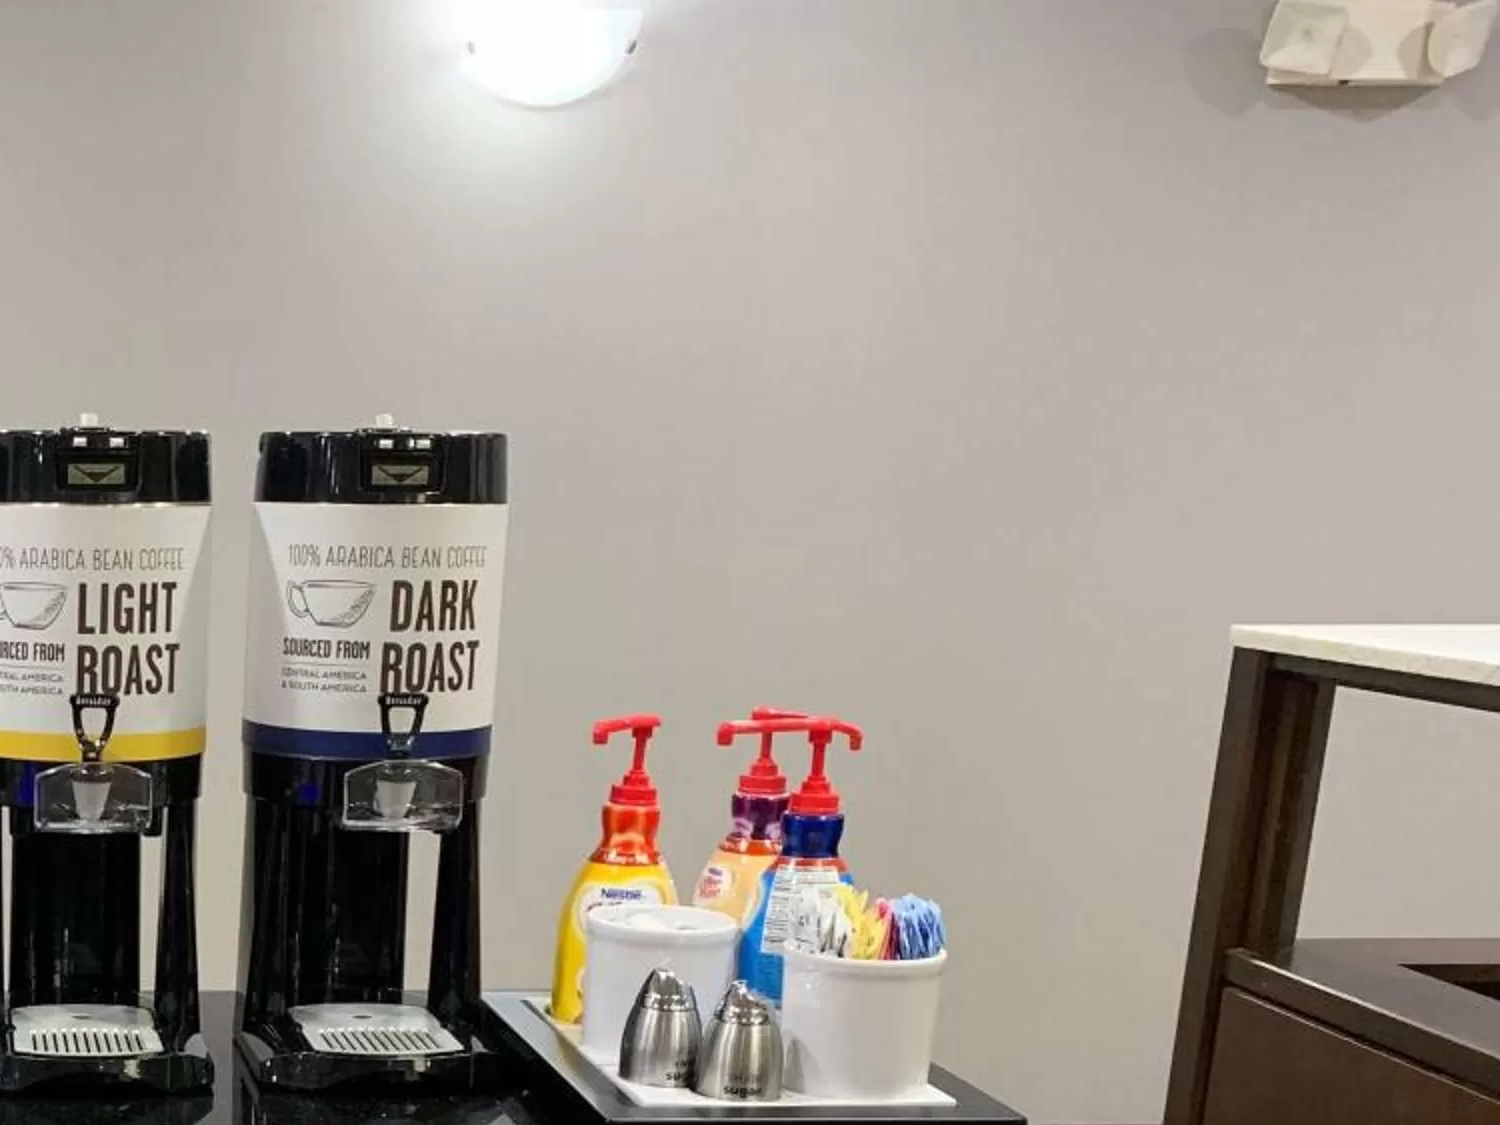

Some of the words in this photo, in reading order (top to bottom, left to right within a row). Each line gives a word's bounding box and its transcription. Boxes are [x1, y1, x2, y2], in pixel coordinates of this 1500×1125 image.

[19, 547, 86, 571] ARABICA
[92, 548, 133, 571] BEAN
[139, 548, 185, 571] COFFEE
[288, 543, 321, 567] 100%
[325, 545, 395, 568] ARABICA
[401, 546, 441, 569] BEAN
[447, 546, 486, 568] COFFEE
[77, 582, 178, 635] LIGHT
[389, 579, 479, 632] DARK
[33, 641, 66, 662] FROM
[283, 637, 332, 658] SOURCED
[335, 640, 371, 660] FROM
[21, 672, 64, 682] AMERICA
[76, 643, 181, 697] ROAST
[320, 670, 367, 680] AMERICA
[381, 640, 480, 693] ROAST
[20, 685, 64, 695] AMERICA
[320, 682, 367, 693] AMERICA
